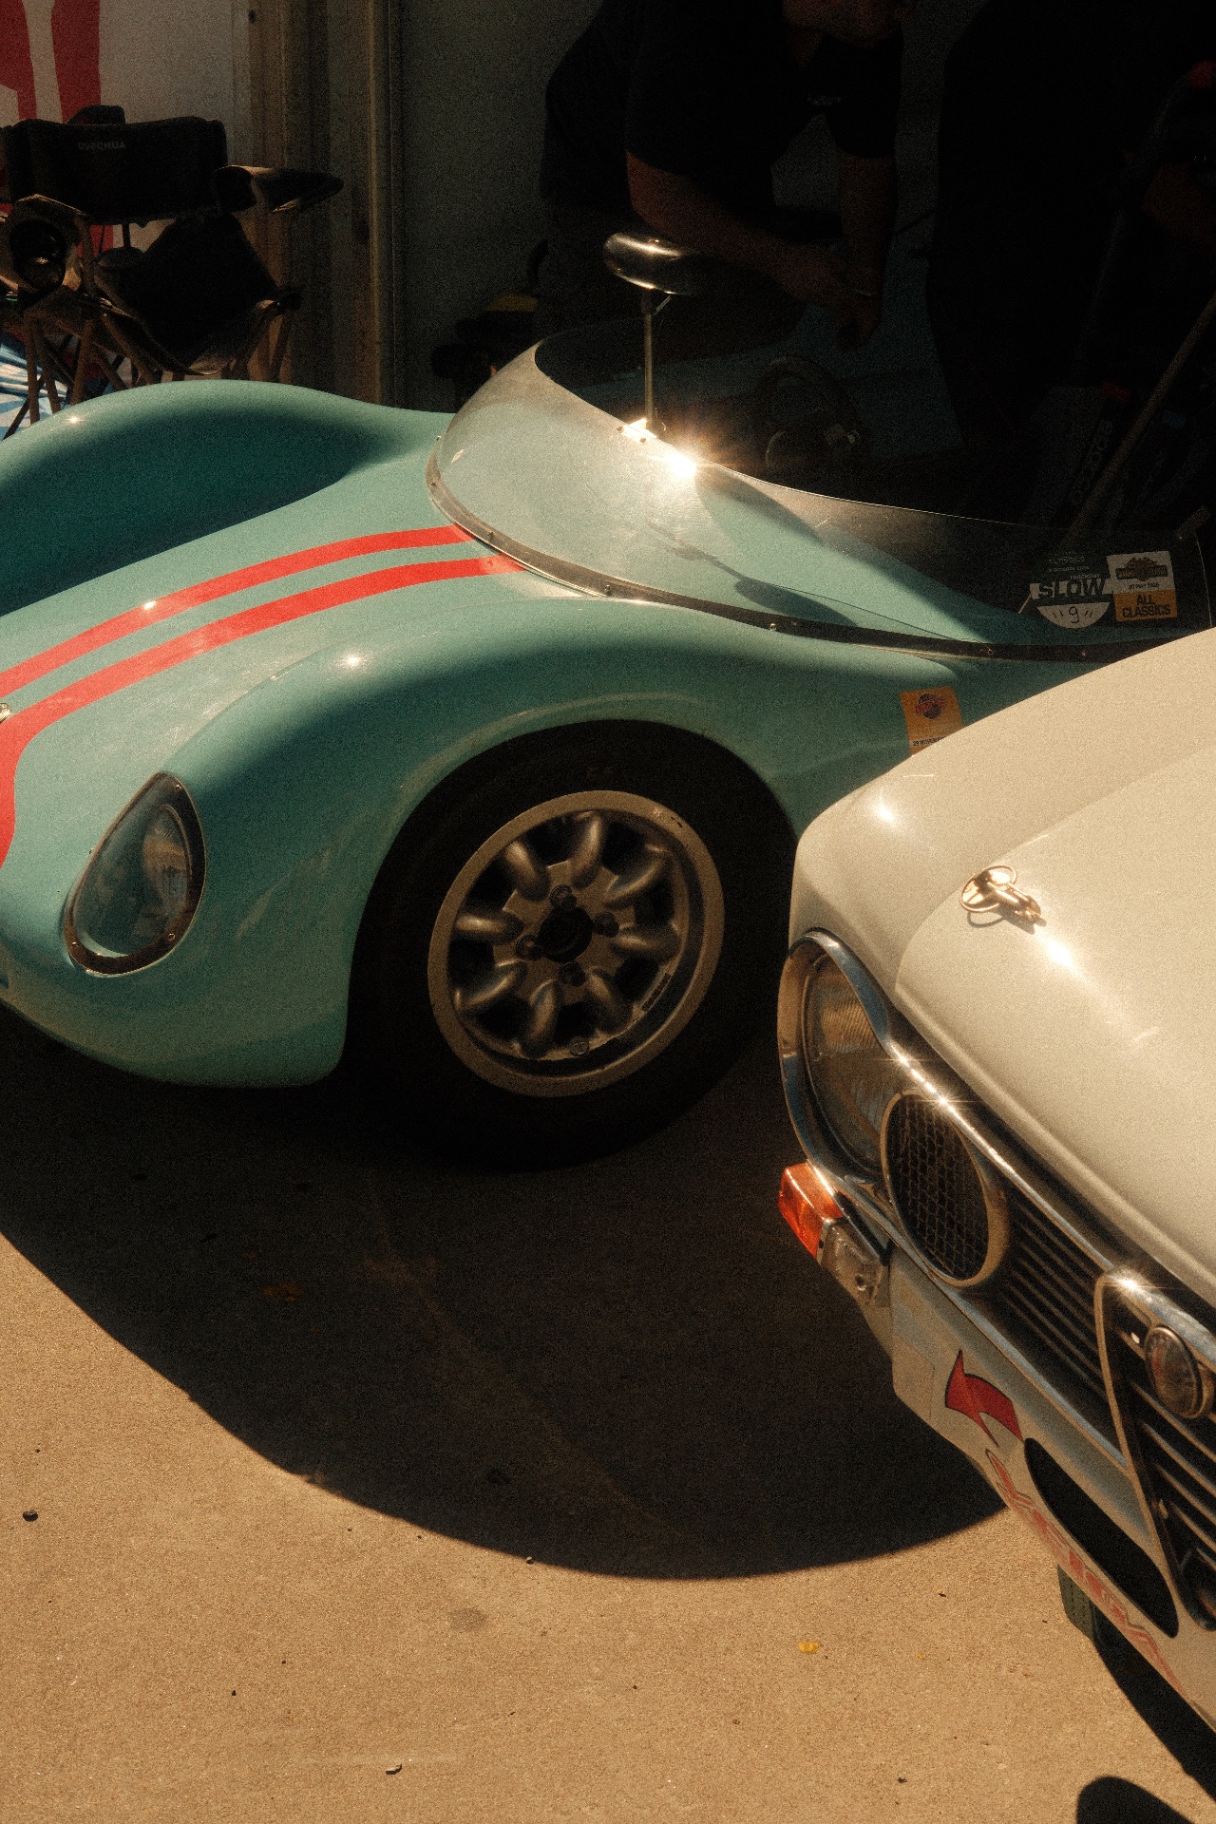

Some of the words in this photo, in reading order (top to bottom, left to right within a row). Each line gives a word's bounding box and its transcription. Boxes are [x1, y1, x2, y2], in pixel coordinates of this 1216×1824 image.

[1038, 578, 1106, 599] SLOW
[1136, 593, 1156, 605] ALL
[1122, 604, 1171, 618] CLASSICS
